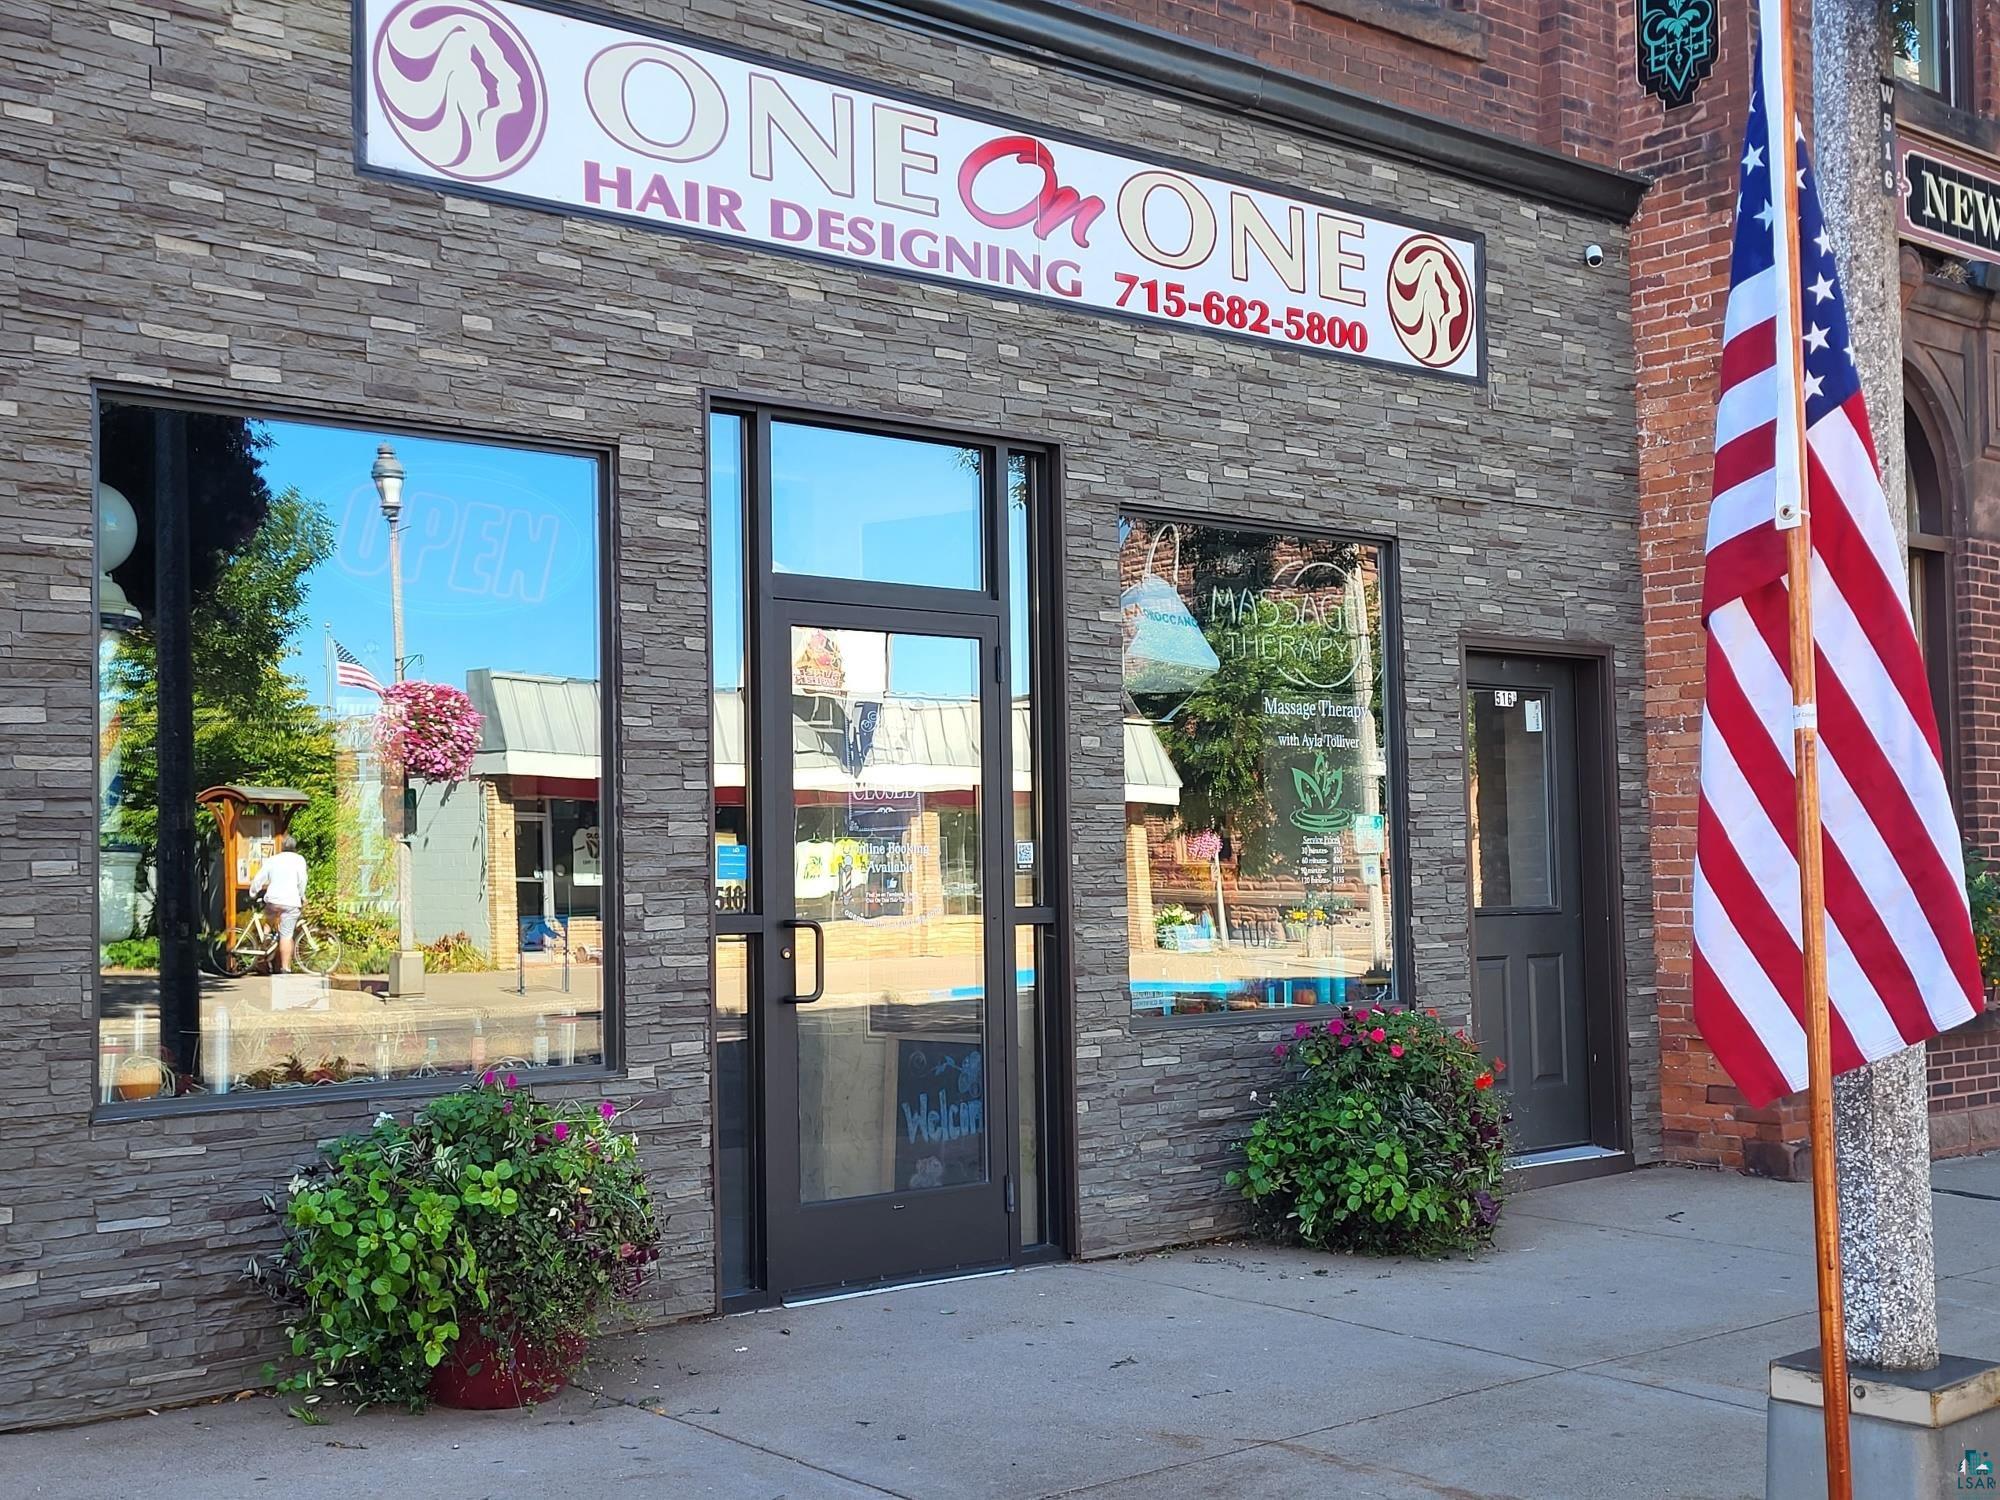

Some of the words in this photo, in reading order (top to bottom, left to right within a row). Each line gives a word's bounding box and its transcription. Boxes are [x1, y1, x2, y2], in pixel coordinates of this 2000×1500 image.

[584, 41, 940, 217] ONE
[957, 135, 1106, 249] On
[1117, 170, 1367, 307] ONE
[583, 160, 746, 233] HAIR
[769, 199, 1083, 298] DESIGNING
[1114, 272, 1368, 353] 715-682-5800
[336, 483, 561, 603] OPEN
[1211, 585, 1358, 634] MASSAGE
[1226, 632, 1349, 662] THERAPY
[1263, 697, 1316, 720] Massage
[1318, 699, 1369, 723] Therapy
[1278, 733, 1300, 747] with
[1302, 733, 1322, 750] Ayla
[1323, 733, 1361, 748] Tolliver
[854, 842, 885, 855] nline
[887, 841, 929, 857] Booking
[868, 861, 914, 874] Available
